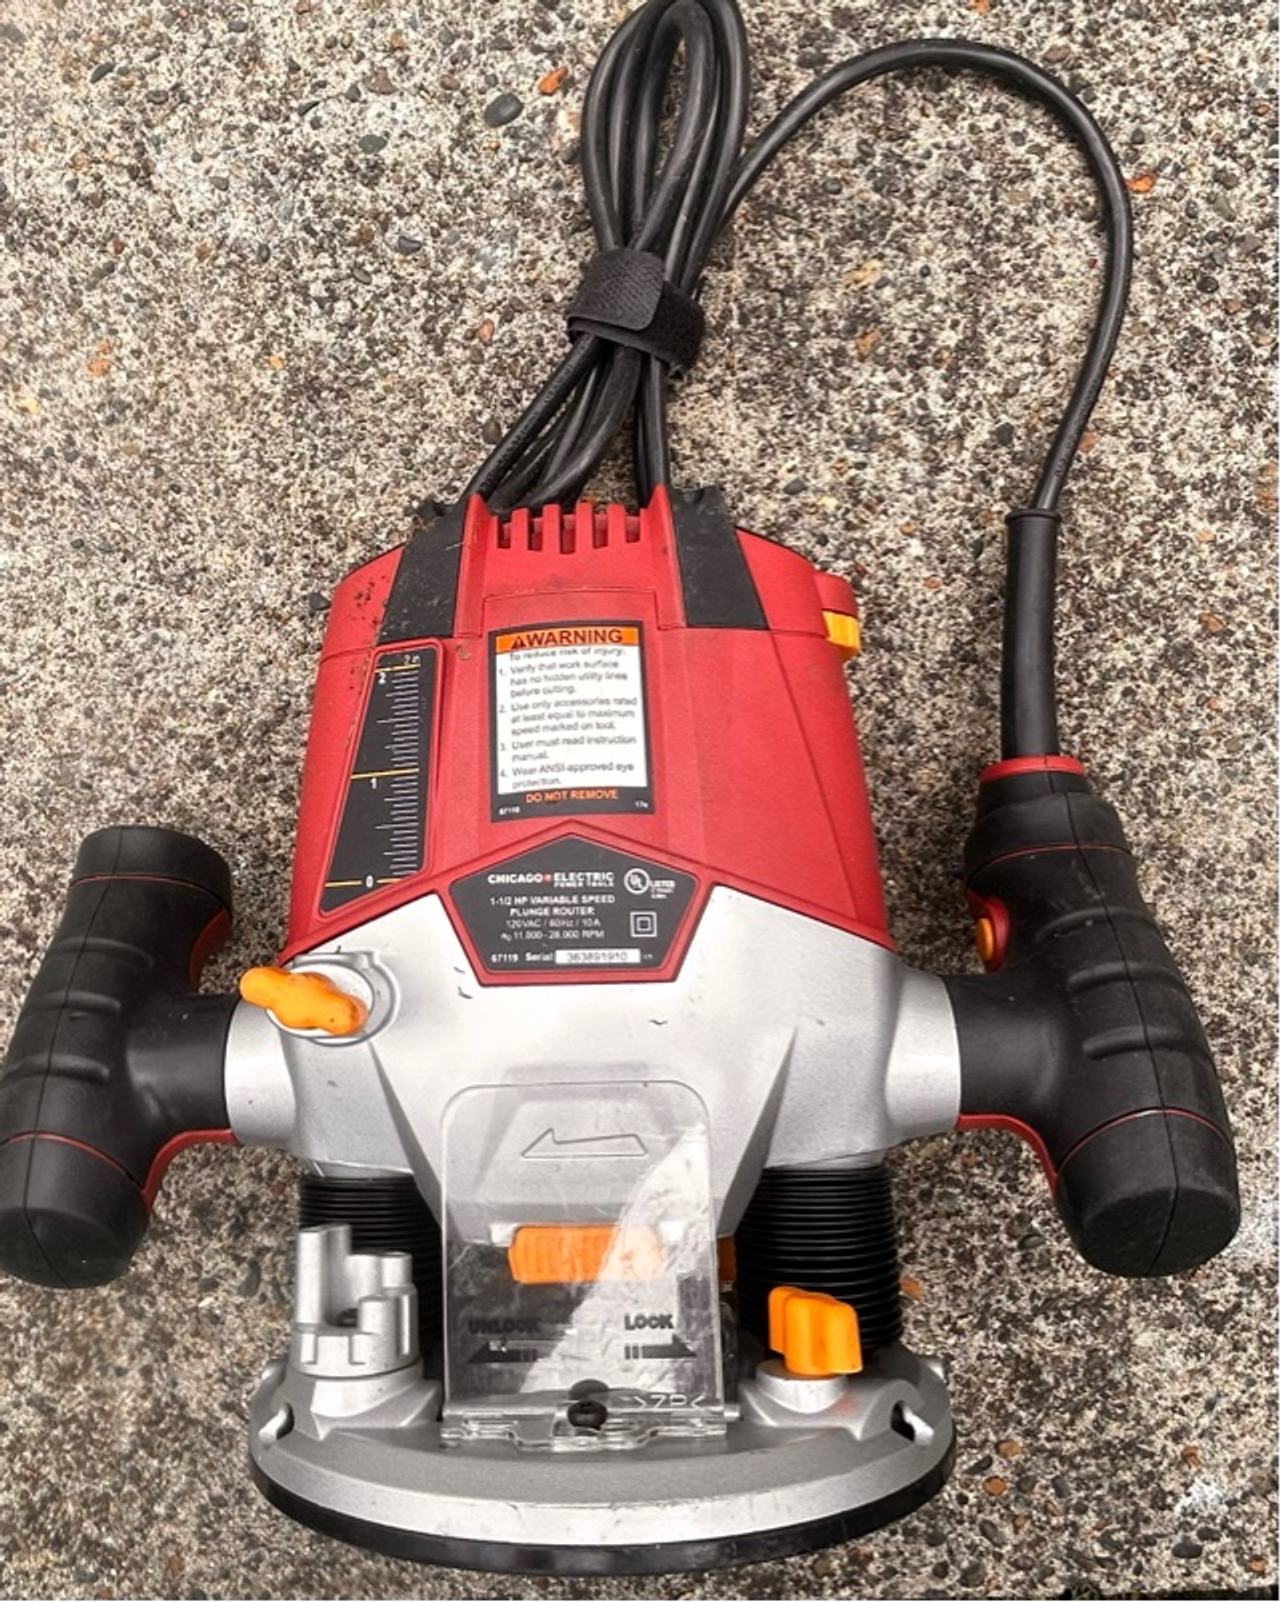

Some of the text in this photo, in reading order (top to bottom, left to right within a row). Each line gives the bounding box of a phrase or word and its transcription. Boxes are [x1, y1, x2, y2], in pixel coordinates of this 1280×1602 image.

[526, 629, 623, 647] WARNING
[523, 650, 556, 660] reduce
[560, 648, 577, 656] risk
[581, 647, 591, 655] of
[510, 664, 536, 674] Verify
[538, 662, 556, 671] that
[559, 660, 581, 669] work
[583, 660, 619, 669] surface
[378, 671, 386, 685] 2
[510, 677, 527, 686] has
[543, 673, 577, 682] hidden
[578, 671, 603, 681] utility
[605, 670, 628, 680] lines
[510, 687, 540, 698] before
[511, 703, 529, 712] Use
[532, 700, 551, 710] only
[554, 698, 610, 707] accessories
[613, 697, 637, 705] rated
[511, 716, 521, 724] at
[523, 713, 545, 722] least
[547, 711, 574, 721] equal
[588, 710, 635, 718] maximum
[511, 726, 540, 736] speed
[542, 722, 579, 732] marked
[580, 722, 593, 730] on
[512, 741, 533, 750] User
[536, 738, 560, 747] must
[562, 736, 584, 745] read
[586, 735, 637, 744] instruction
[512, 767, 537, 776] Wear
[616, 763, 634, 773] eye
[370, 777, 377, 789] 1
[526, 789, 619, 803] DO NOT REMOVE
[366, 875, 374, 888] 0
[487, 871, 615, 884] CHICAGO ELECTRIC
[514, 896, 528, 905] HP
[530, 895, 579, 904] VARIABLE
[581, 894, 615, 904] SPEED
[510, 906, 595, 917] PLUNGE ROUTER
[506, 919, 541, 928] 120VAC
[549, 919, 574, 927] 60Hz
[582, 930, 605, 939] RPM
[491, 953, 519, 963] 67119
[467, 1318, 541, 1335] UNLOCK
